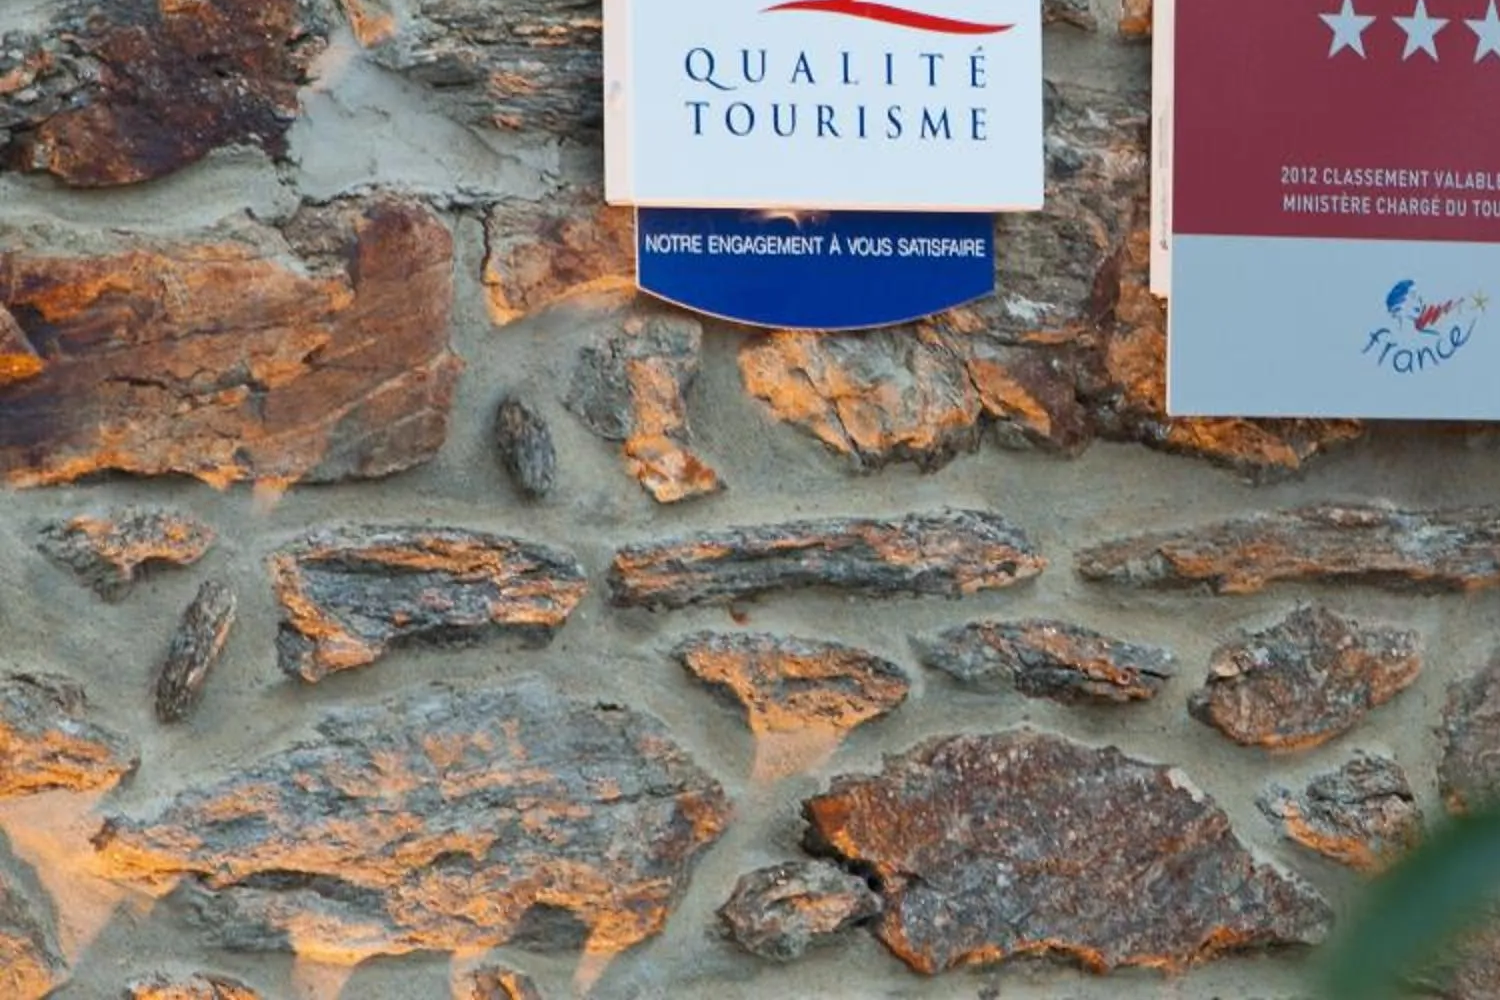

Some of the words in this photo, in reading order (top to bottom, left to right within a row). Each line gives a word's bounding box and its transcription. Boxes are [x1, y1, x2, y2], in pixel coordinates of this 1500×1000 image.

[684, 46, 987, 91] QUALITÉ
[684, 101, 988, 141] TOURISME
[1281, 165, 1318, 185] 2012
[1322, 166, 1430, 189] CLASSEMENT
[1283, 190, 1372, 215] MINISTÈRE
[1375, 194, 1441, 217] CHARGÉ
[1445, 198, 1467, 217] DU
[645, 233, 702, 254] NOTRE
[708, 236, 824, 256] ENGAGEMENT
[828, 234, 842, 256] À
[846, 237, 894, 257] VOUS
[897, 237, 986, 258] SATISFAIRE
